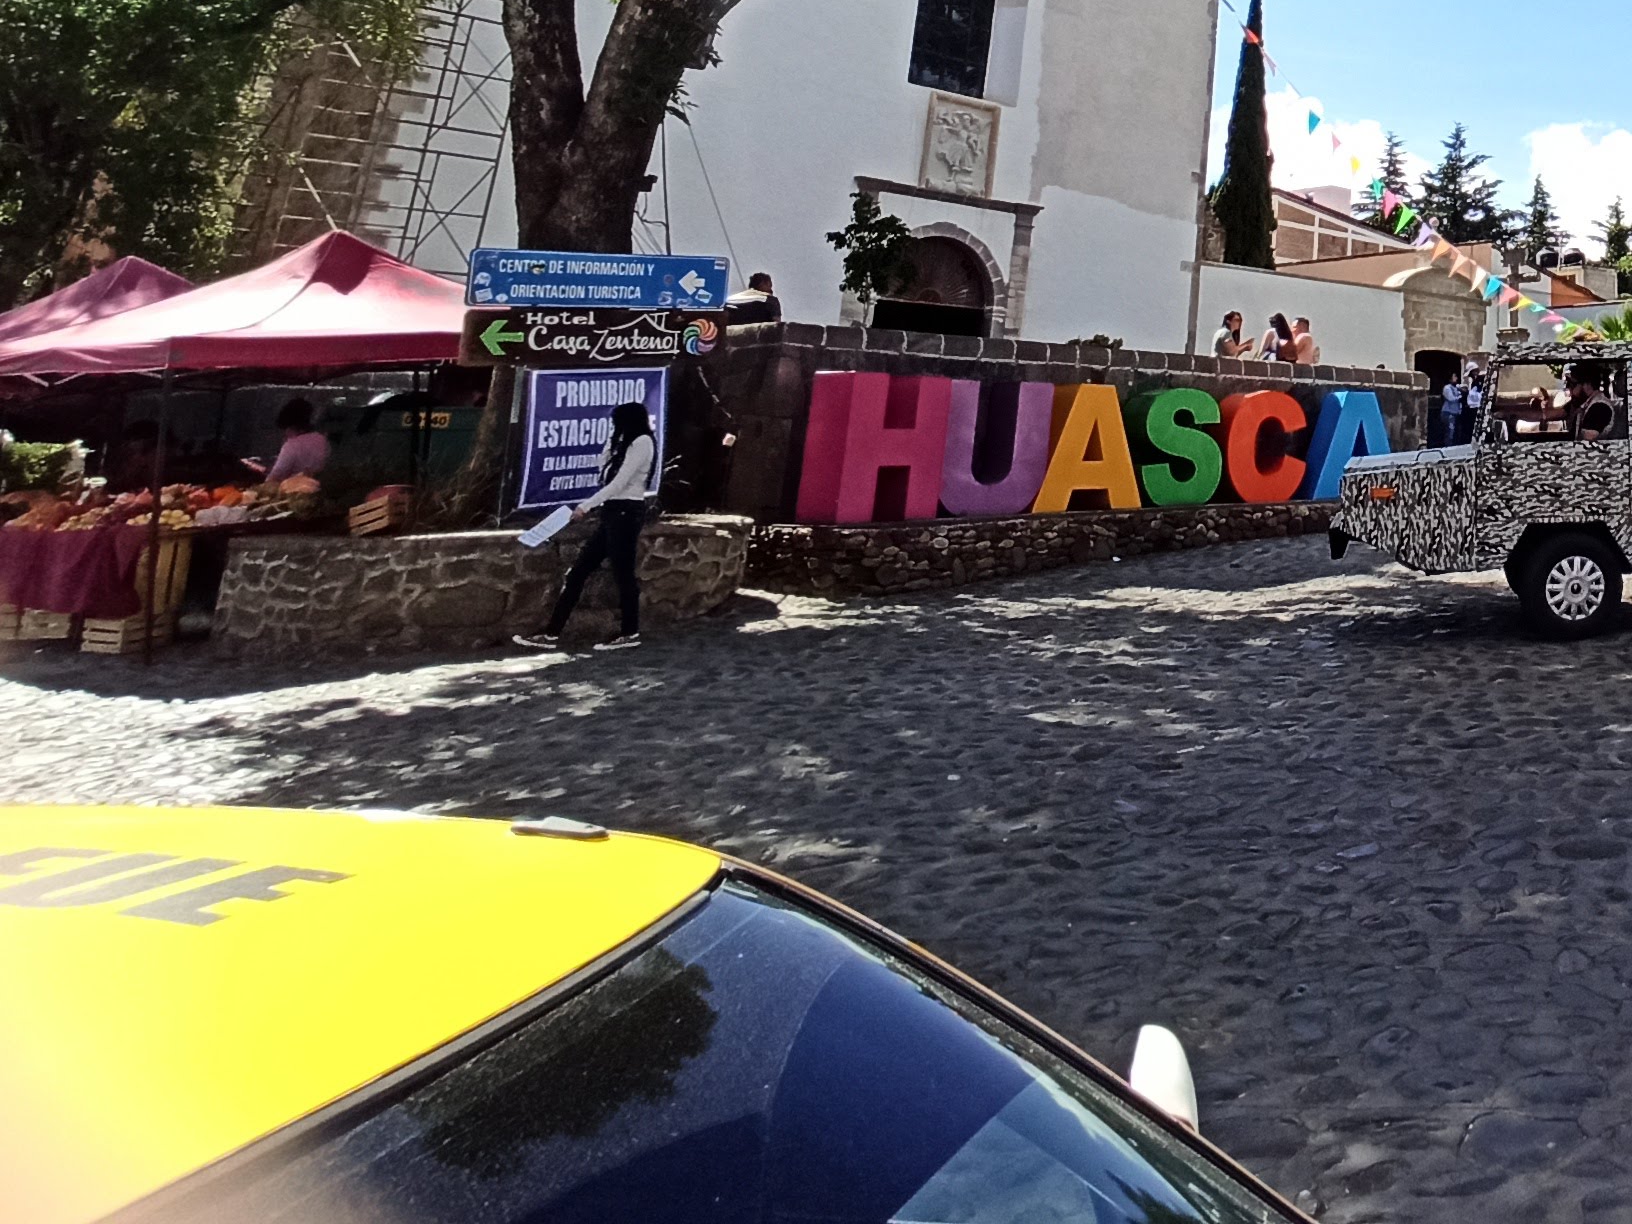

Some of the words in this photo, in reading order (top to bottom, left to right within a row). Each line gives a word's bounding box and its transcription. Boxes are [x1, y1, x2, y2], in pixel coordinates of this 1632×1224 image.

[549, 260, 563, 274] DE
[567, 259, 642, 276] INFORMACIÓN
[648, 263, 655, 276] Y
[588, 285, 642, 300] TURISTICA
[526, 311, 596, 325] Hotel
[528, 326, 591, 355] Casa
[589, 329, 674, 361] Zenteno
[556, 378, 646, 408] PROHIBIDO
[798, 370, 1393, 524] HUASCA
